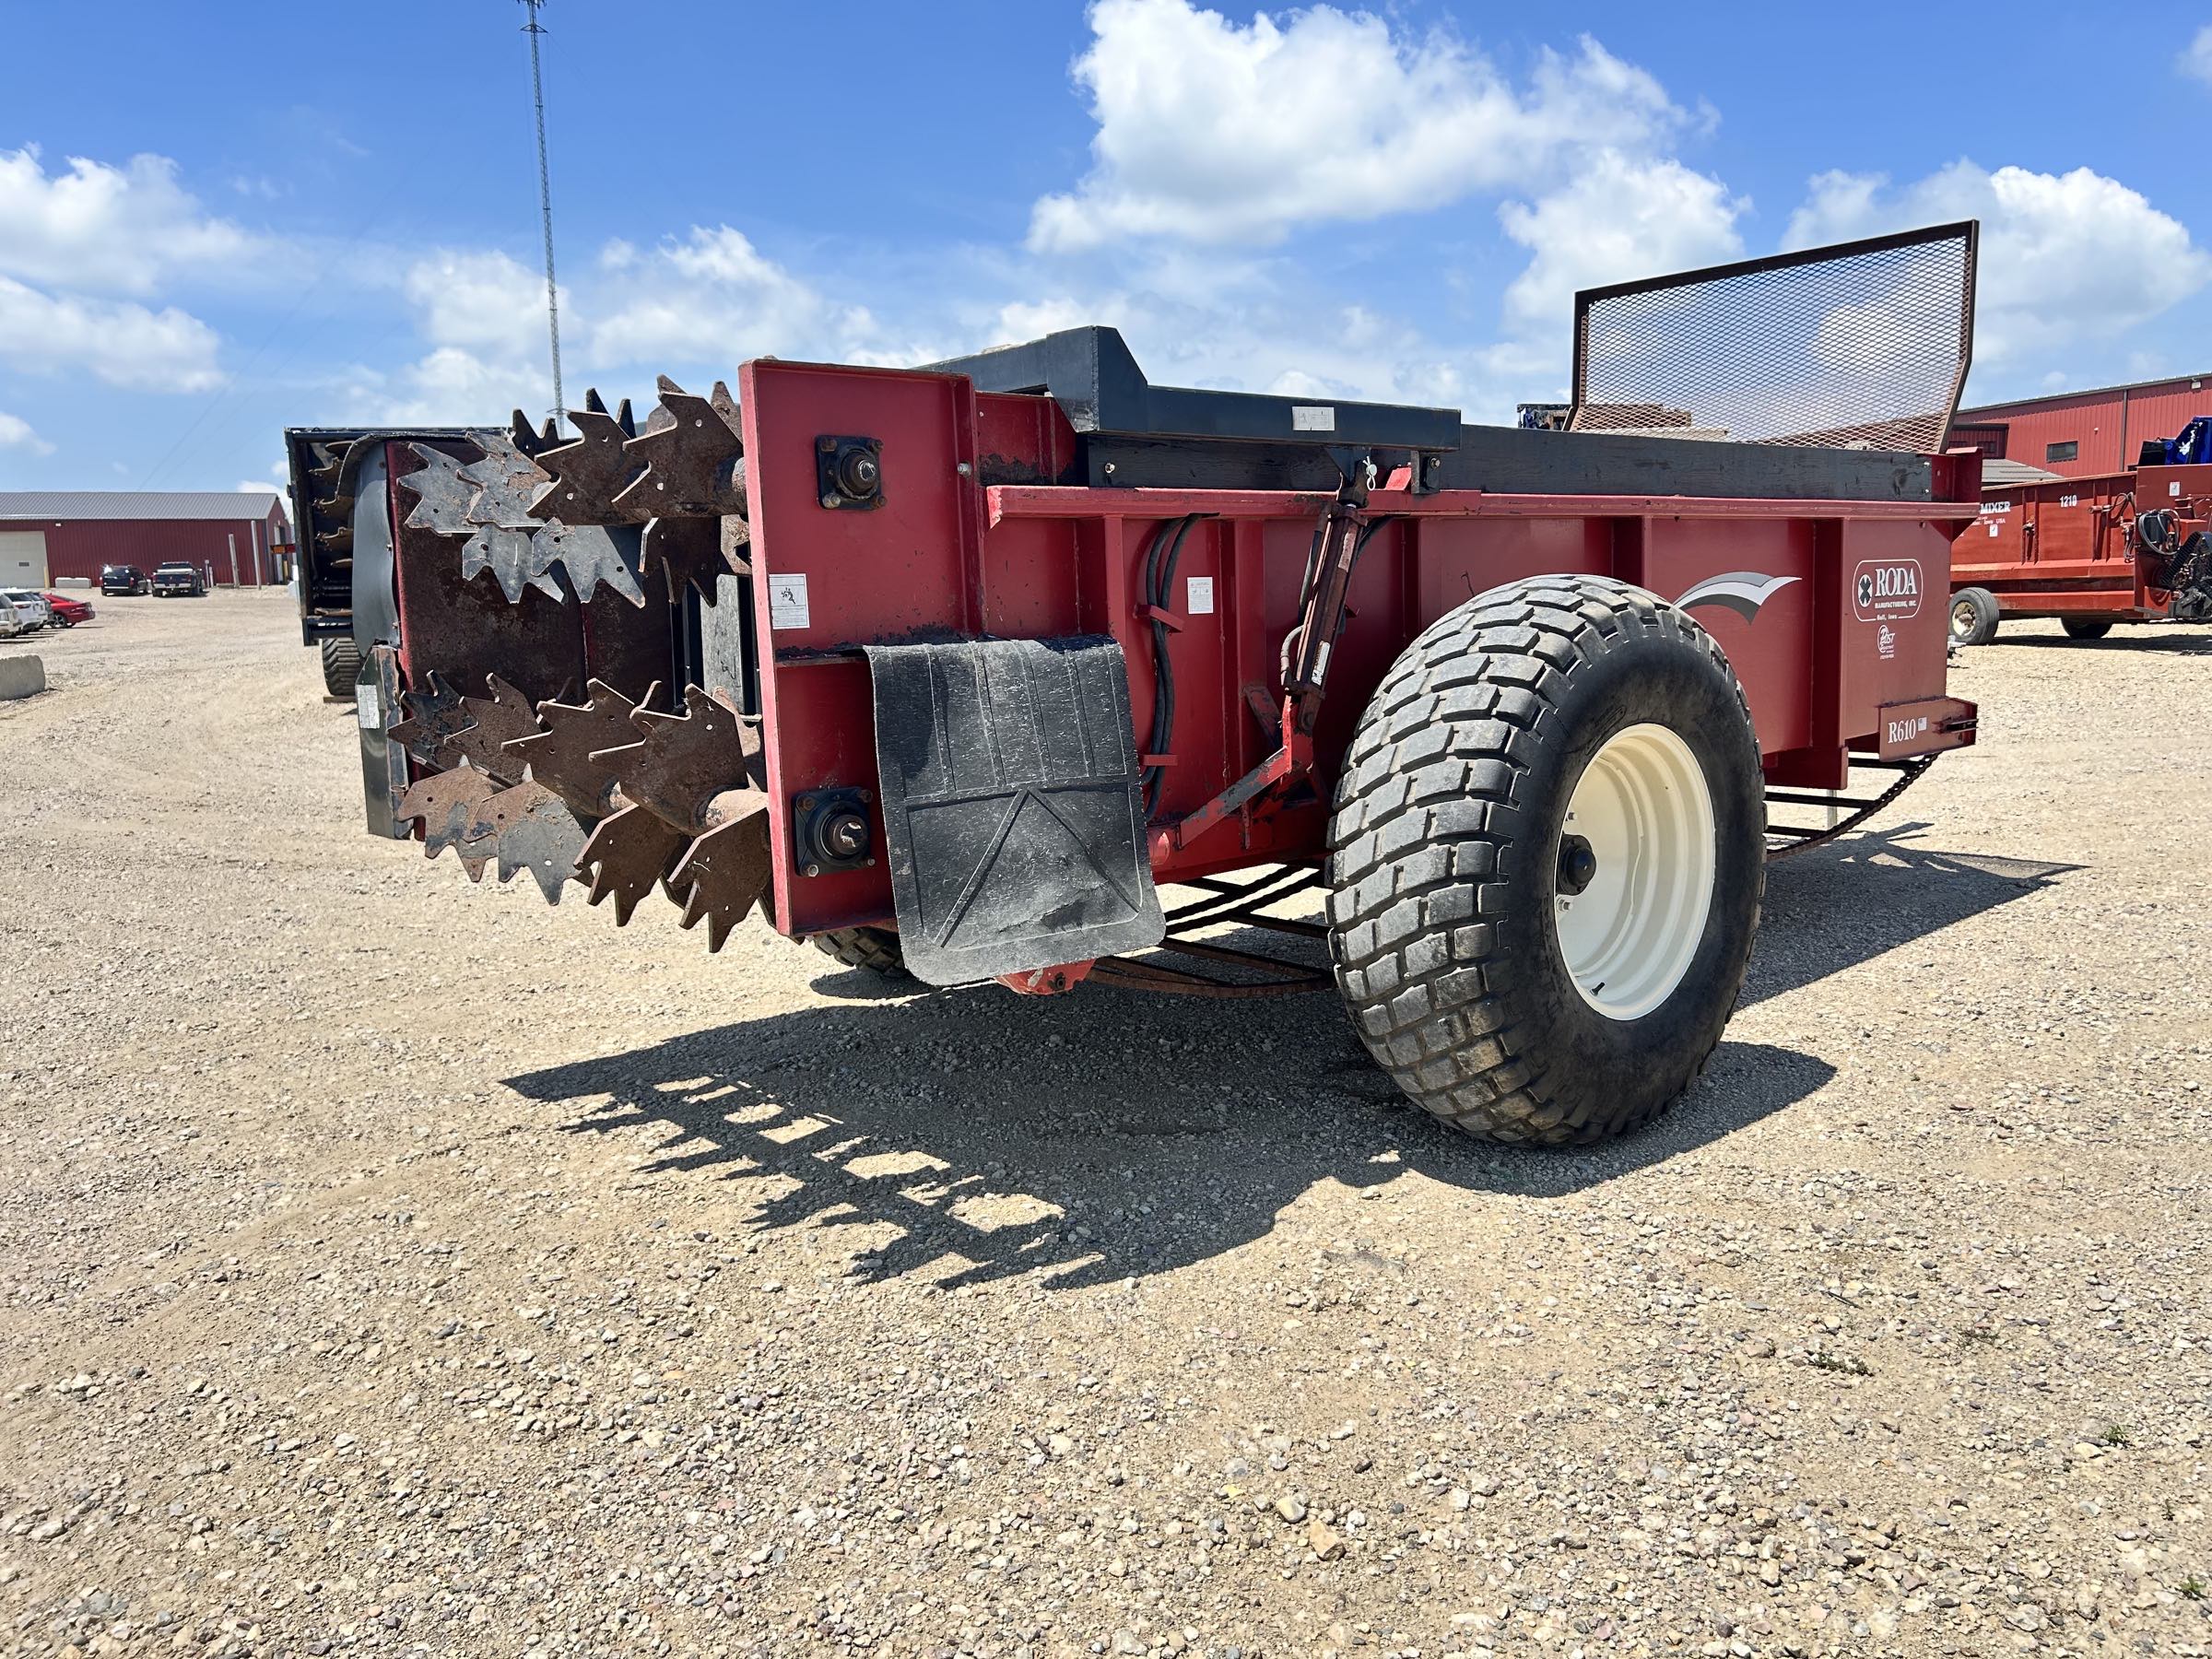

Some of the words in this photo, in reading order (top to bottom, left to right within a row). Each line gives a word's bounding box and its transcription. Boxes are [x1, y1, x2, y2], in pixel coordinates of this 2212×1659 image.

[1980, 501, 2011, 514] MIXER
[1875, 568, 1917, 596] RODA
[1888, 719, 1916, 744] R610
